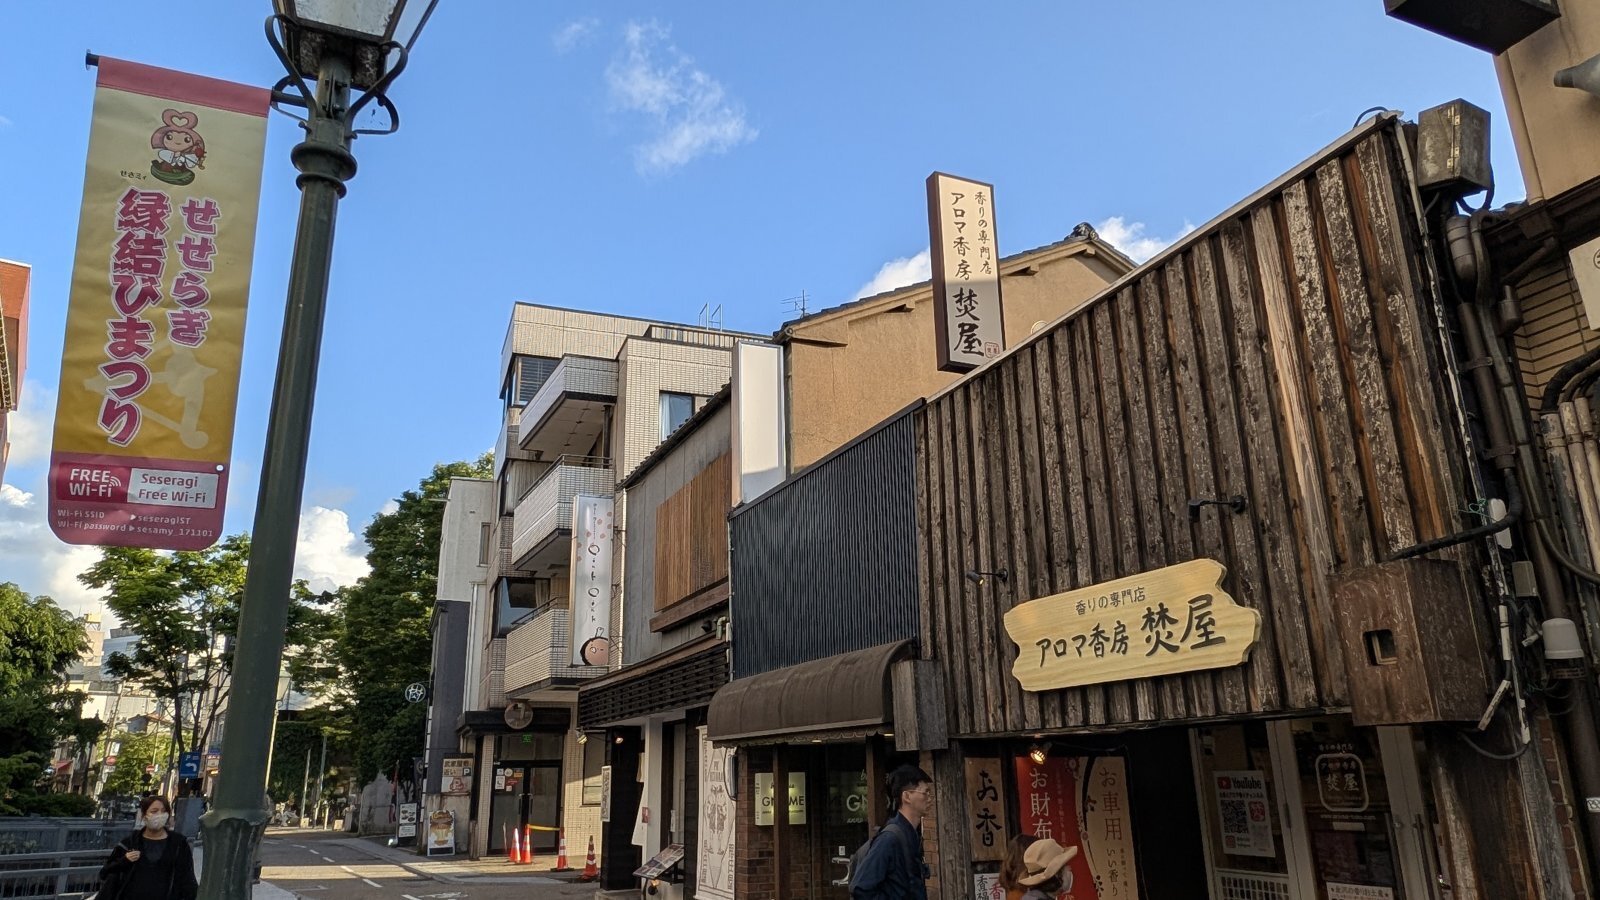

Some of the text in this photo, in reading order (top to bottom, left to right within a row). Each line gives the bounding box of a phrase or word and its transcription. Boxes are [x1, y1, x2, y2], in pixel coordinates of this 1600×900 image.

[974, 191, 992, 275] 香りの専門店
[170, 199, 219, 345] せせらぎ
[951, 192, 984, 357] アロマ香房 焚屋
[100, 188, 170, 445] 縁結びまつり
[69, 482, 112, 498] Wi-Fi
[70, 468, 111, 483] FREE
[141, 473, 198, 489] Seseragi
[57, 509, 83, 517] Wi-Fi
[84, 510, 105, 519] SSID
[138, 488, 206, 504] Free Wi-Fi
[57, 520, 83, 529] Wi-Fi
[83, 522, 126, 532] password
[1075, 586, 1146, 616] 香りの専門店
[1036, 593, 1226, 667] アロマ香房 焚屋
[463, 768, 470, 776] P
[1232, 776, 1262, 789] YouTube
[976, 768, 1002, 847] お香
[1029, 767, 1053, 839] お財布
[1100, 767, 1123, 841] お車用
[1107, 848, 1119, 897] いい香り
